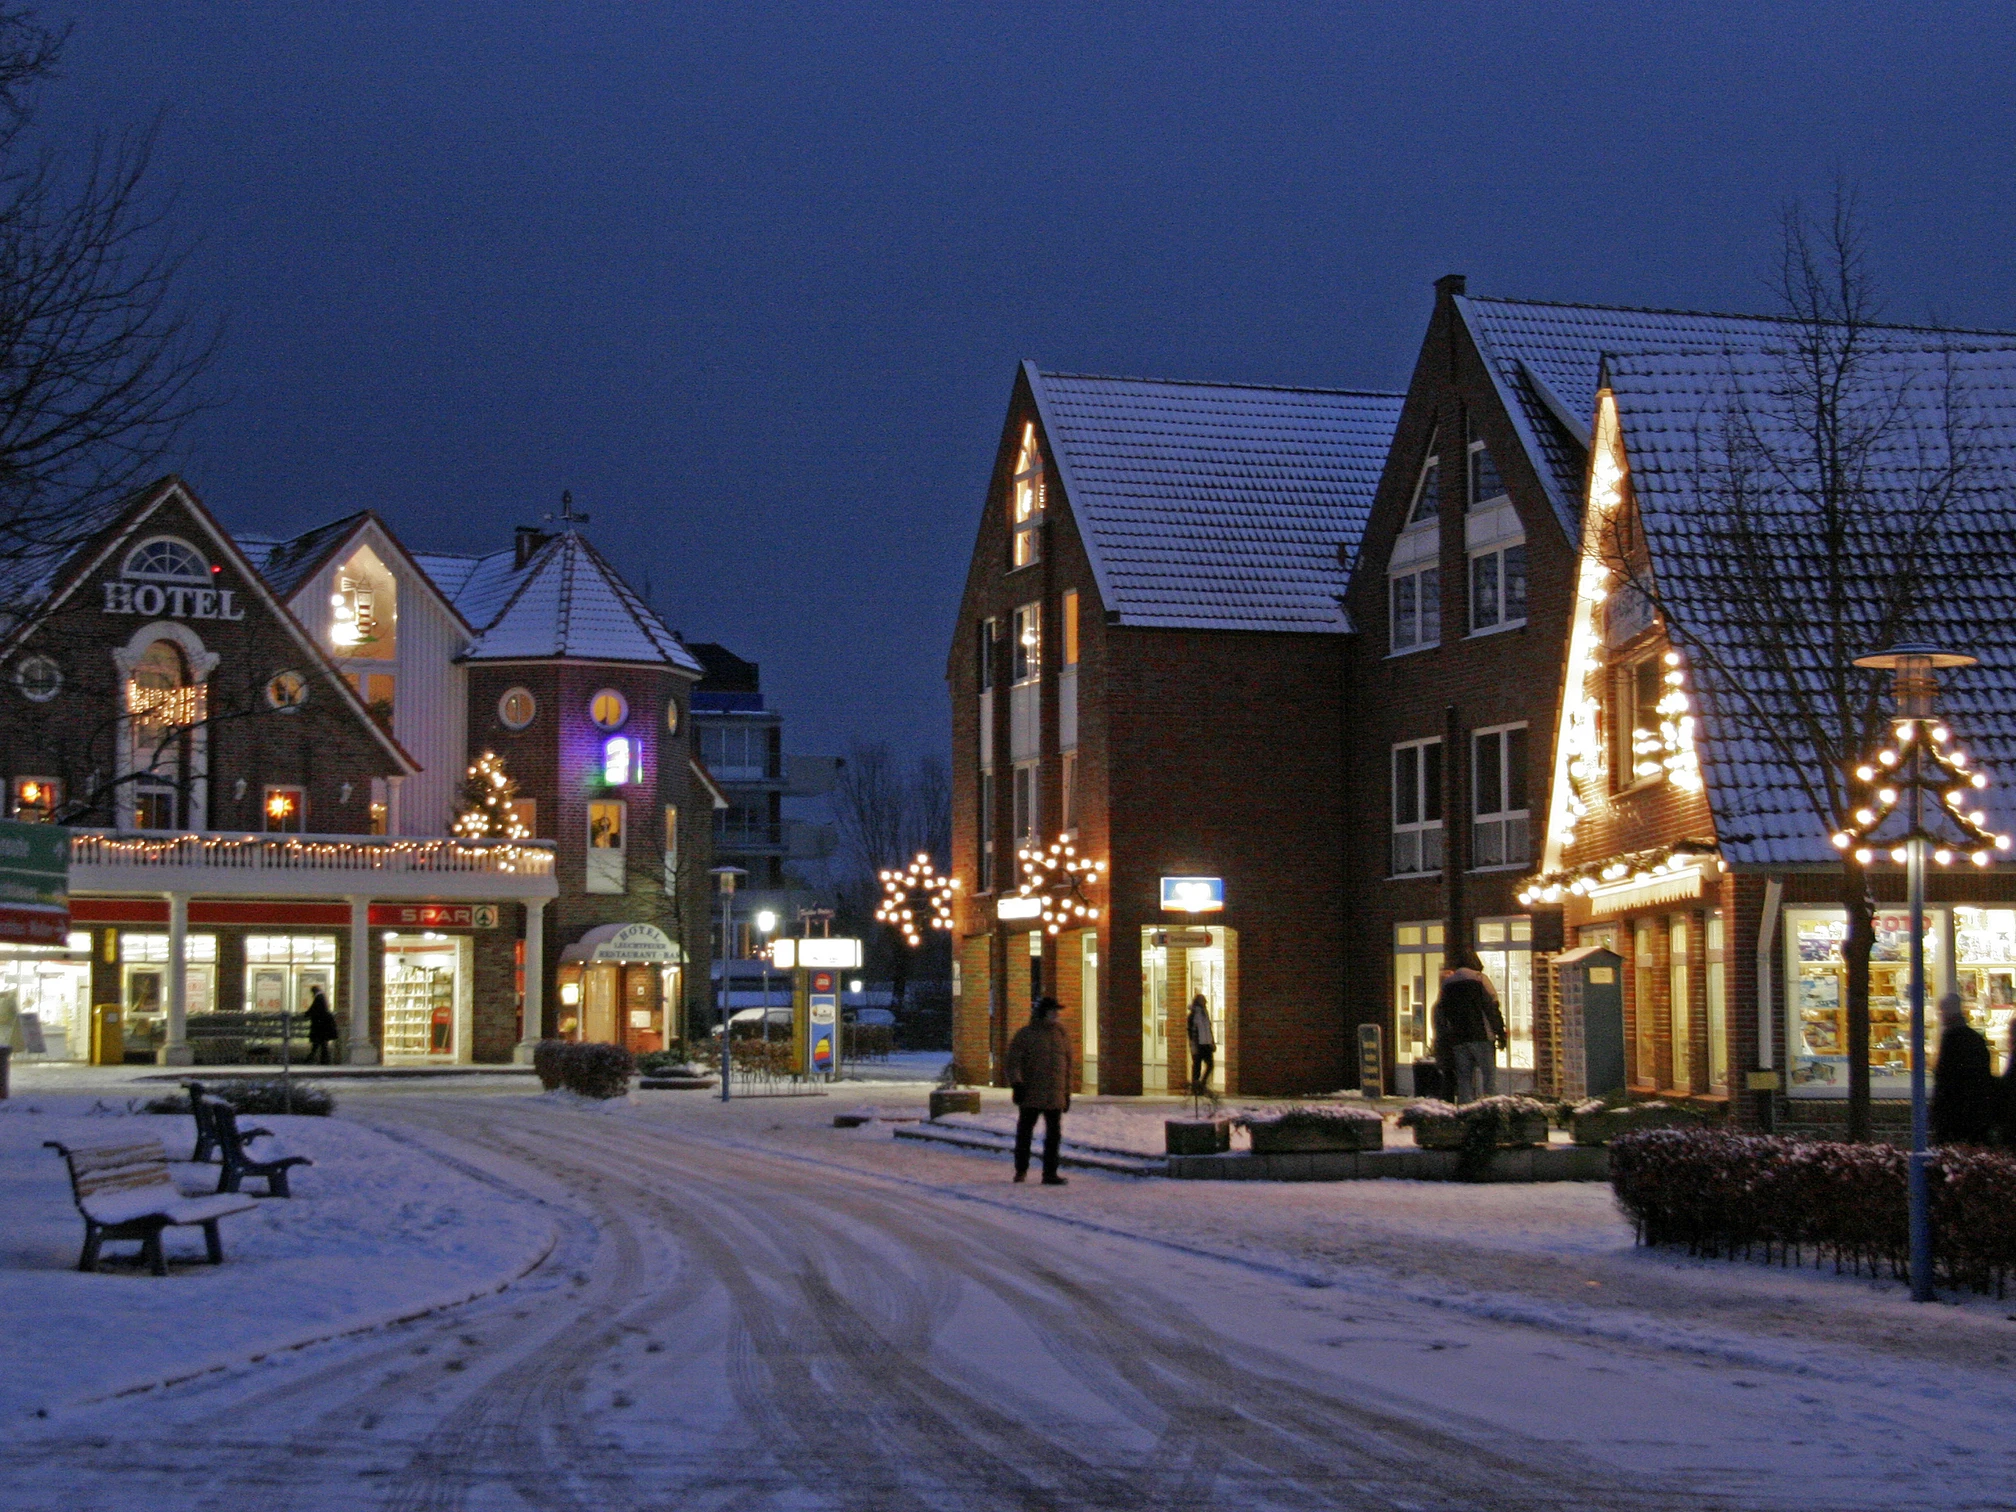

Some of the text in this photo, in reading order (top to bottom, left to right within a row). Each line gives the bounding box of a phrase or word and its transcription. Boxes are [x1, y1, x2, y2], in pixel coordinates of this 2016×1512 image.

[102, 582, 245, 621] HOTEL
[401, 909, 471, 922] SPAR
[620, 926, 660, 940] HOTEL
